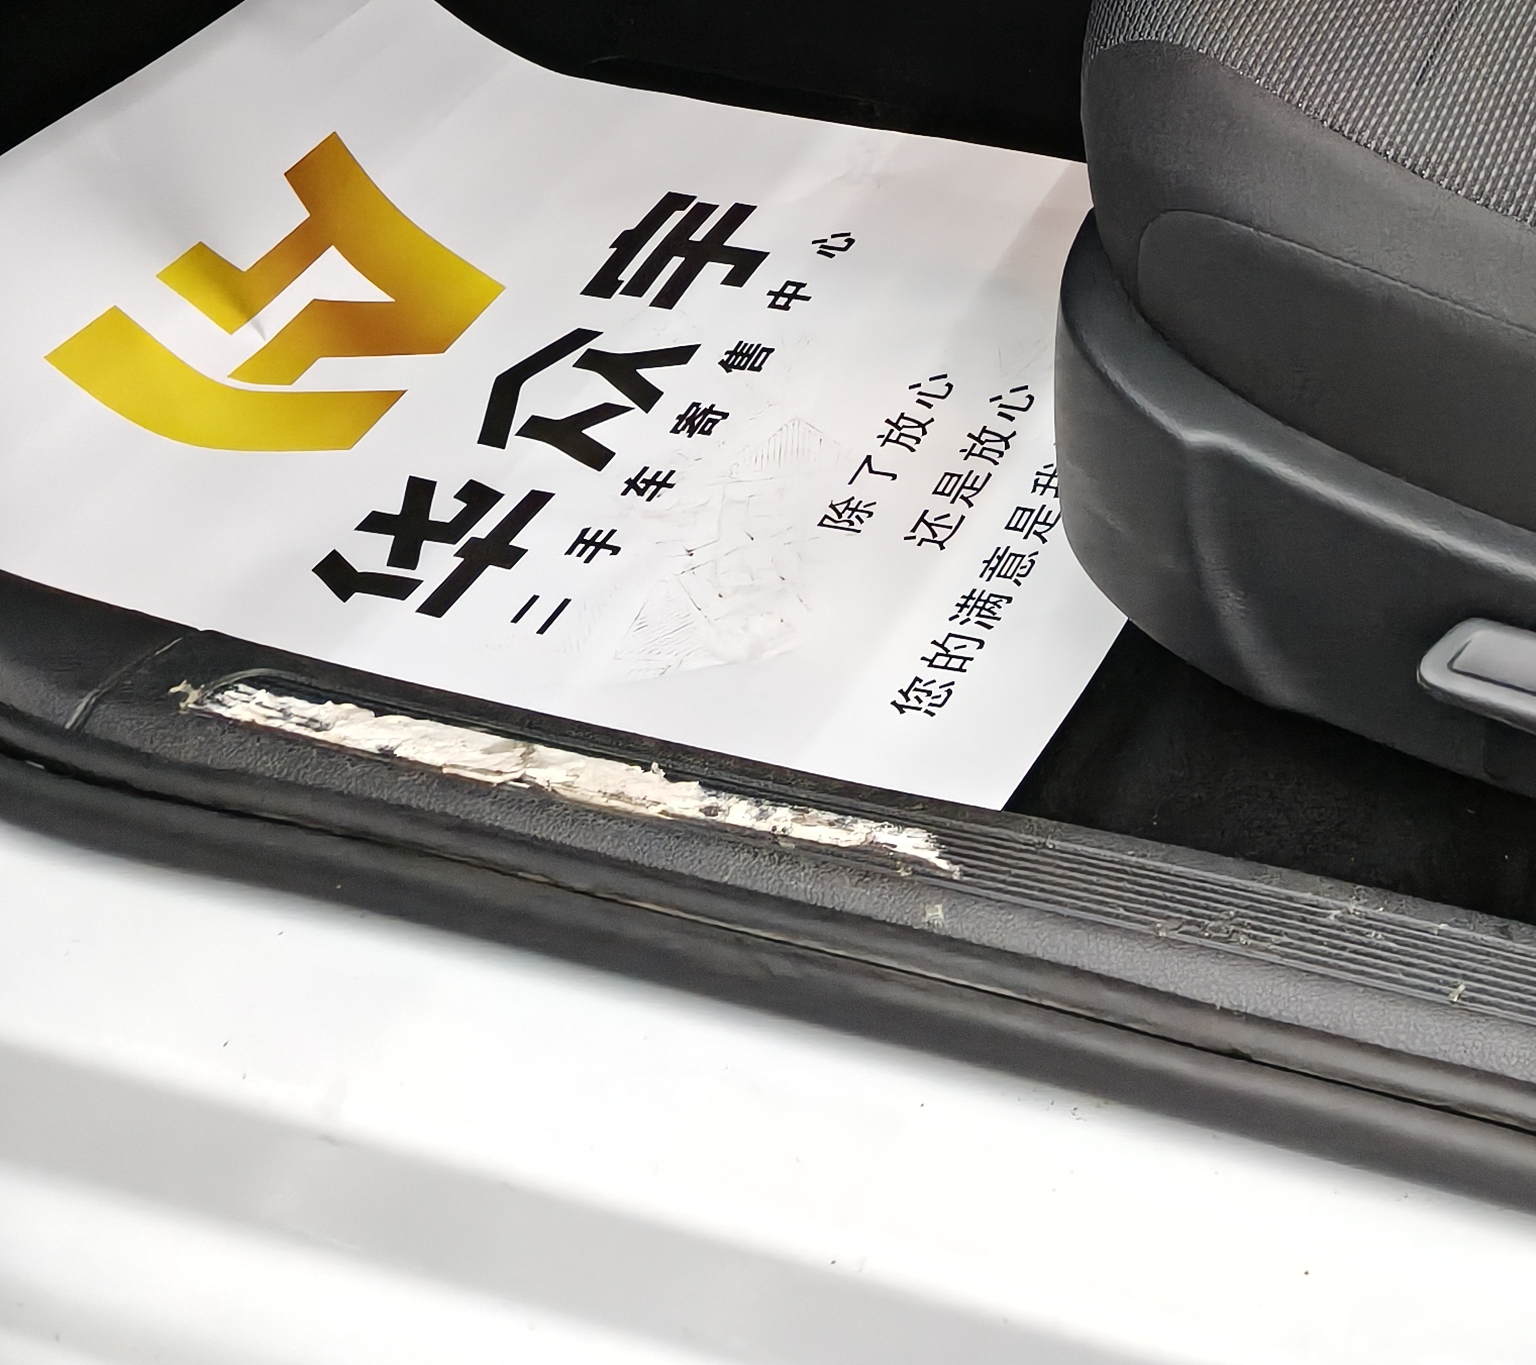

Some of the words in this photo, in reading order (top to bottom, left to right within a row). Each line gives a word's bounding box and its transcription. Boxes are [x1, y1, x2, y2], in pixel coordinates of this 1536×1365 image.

[312, 190, 769, 619] 华众宇
[511, 230, 857, 637] 二手车寄售中心
[817, 373, 954, 534] 除了放心
[903, 384, 1036, 551] 还是放心
